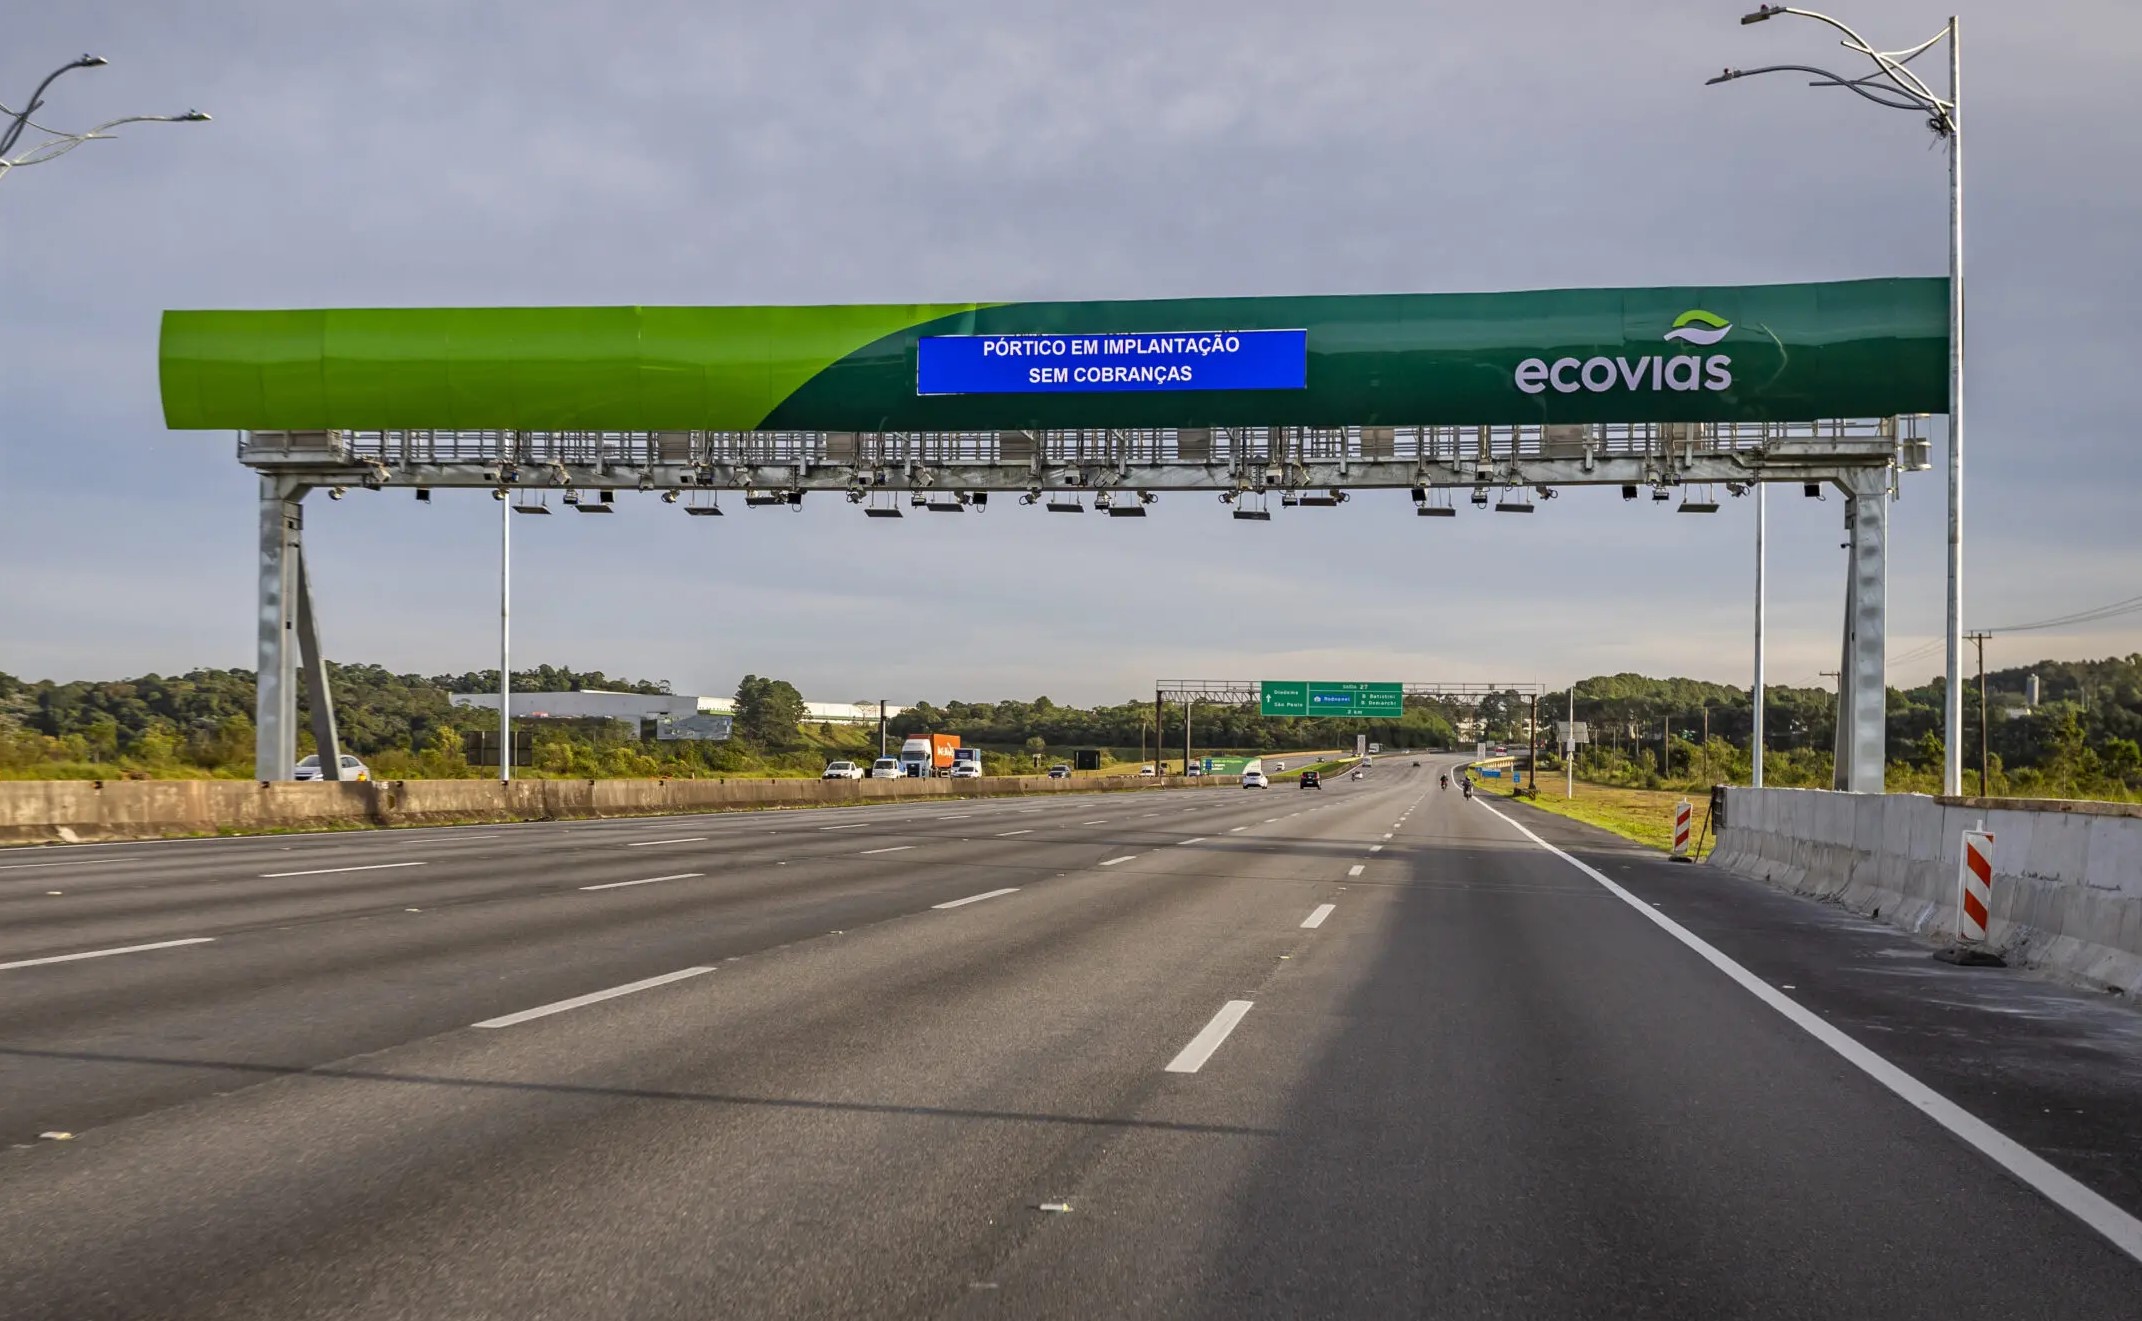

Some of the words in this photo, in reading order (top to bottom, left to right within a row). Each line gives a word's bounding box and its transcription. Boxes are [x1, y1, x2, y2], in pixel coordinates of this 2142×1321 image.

[983, 337, 1066, 357] PÓRTICO
[1071, 338, 1099, 355] EM
[1104, 333, 1240, 356] IMPLANTAÇÃO
[1029, 367, 1069, 384] SEM
[1073, 365, 1193, 386] COBRANÇAS
[1515, 354, 1732, 394] ecovias
